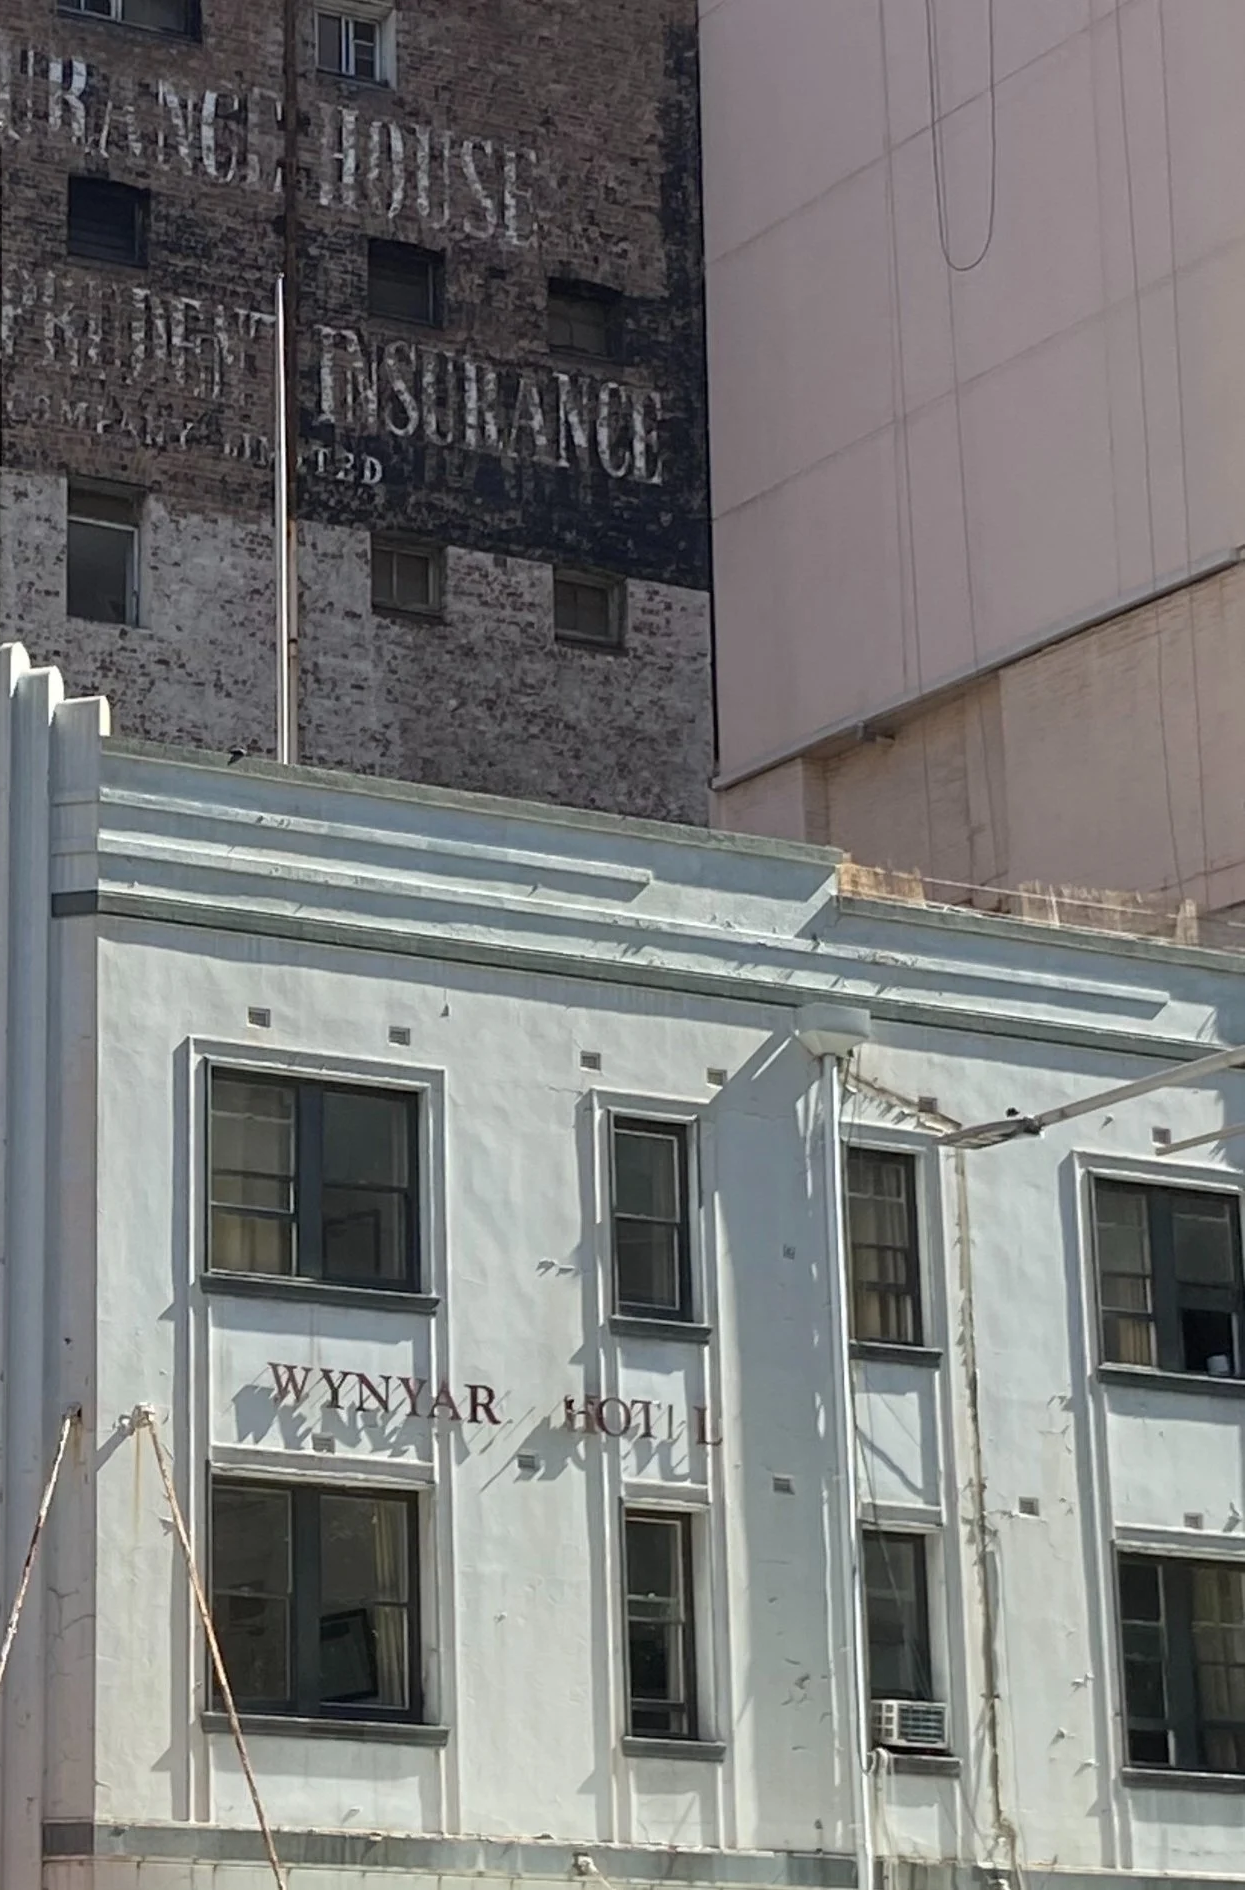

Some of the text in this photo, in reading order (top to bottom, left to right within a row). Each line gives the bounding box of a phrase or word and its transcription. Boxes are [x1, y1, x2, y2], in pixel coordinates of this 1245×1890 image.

[317, 100, 539, 247] HOUSE
[223, 432, 383, 483] LIMTED
[313, 325, 663, 485] INSURANCE
